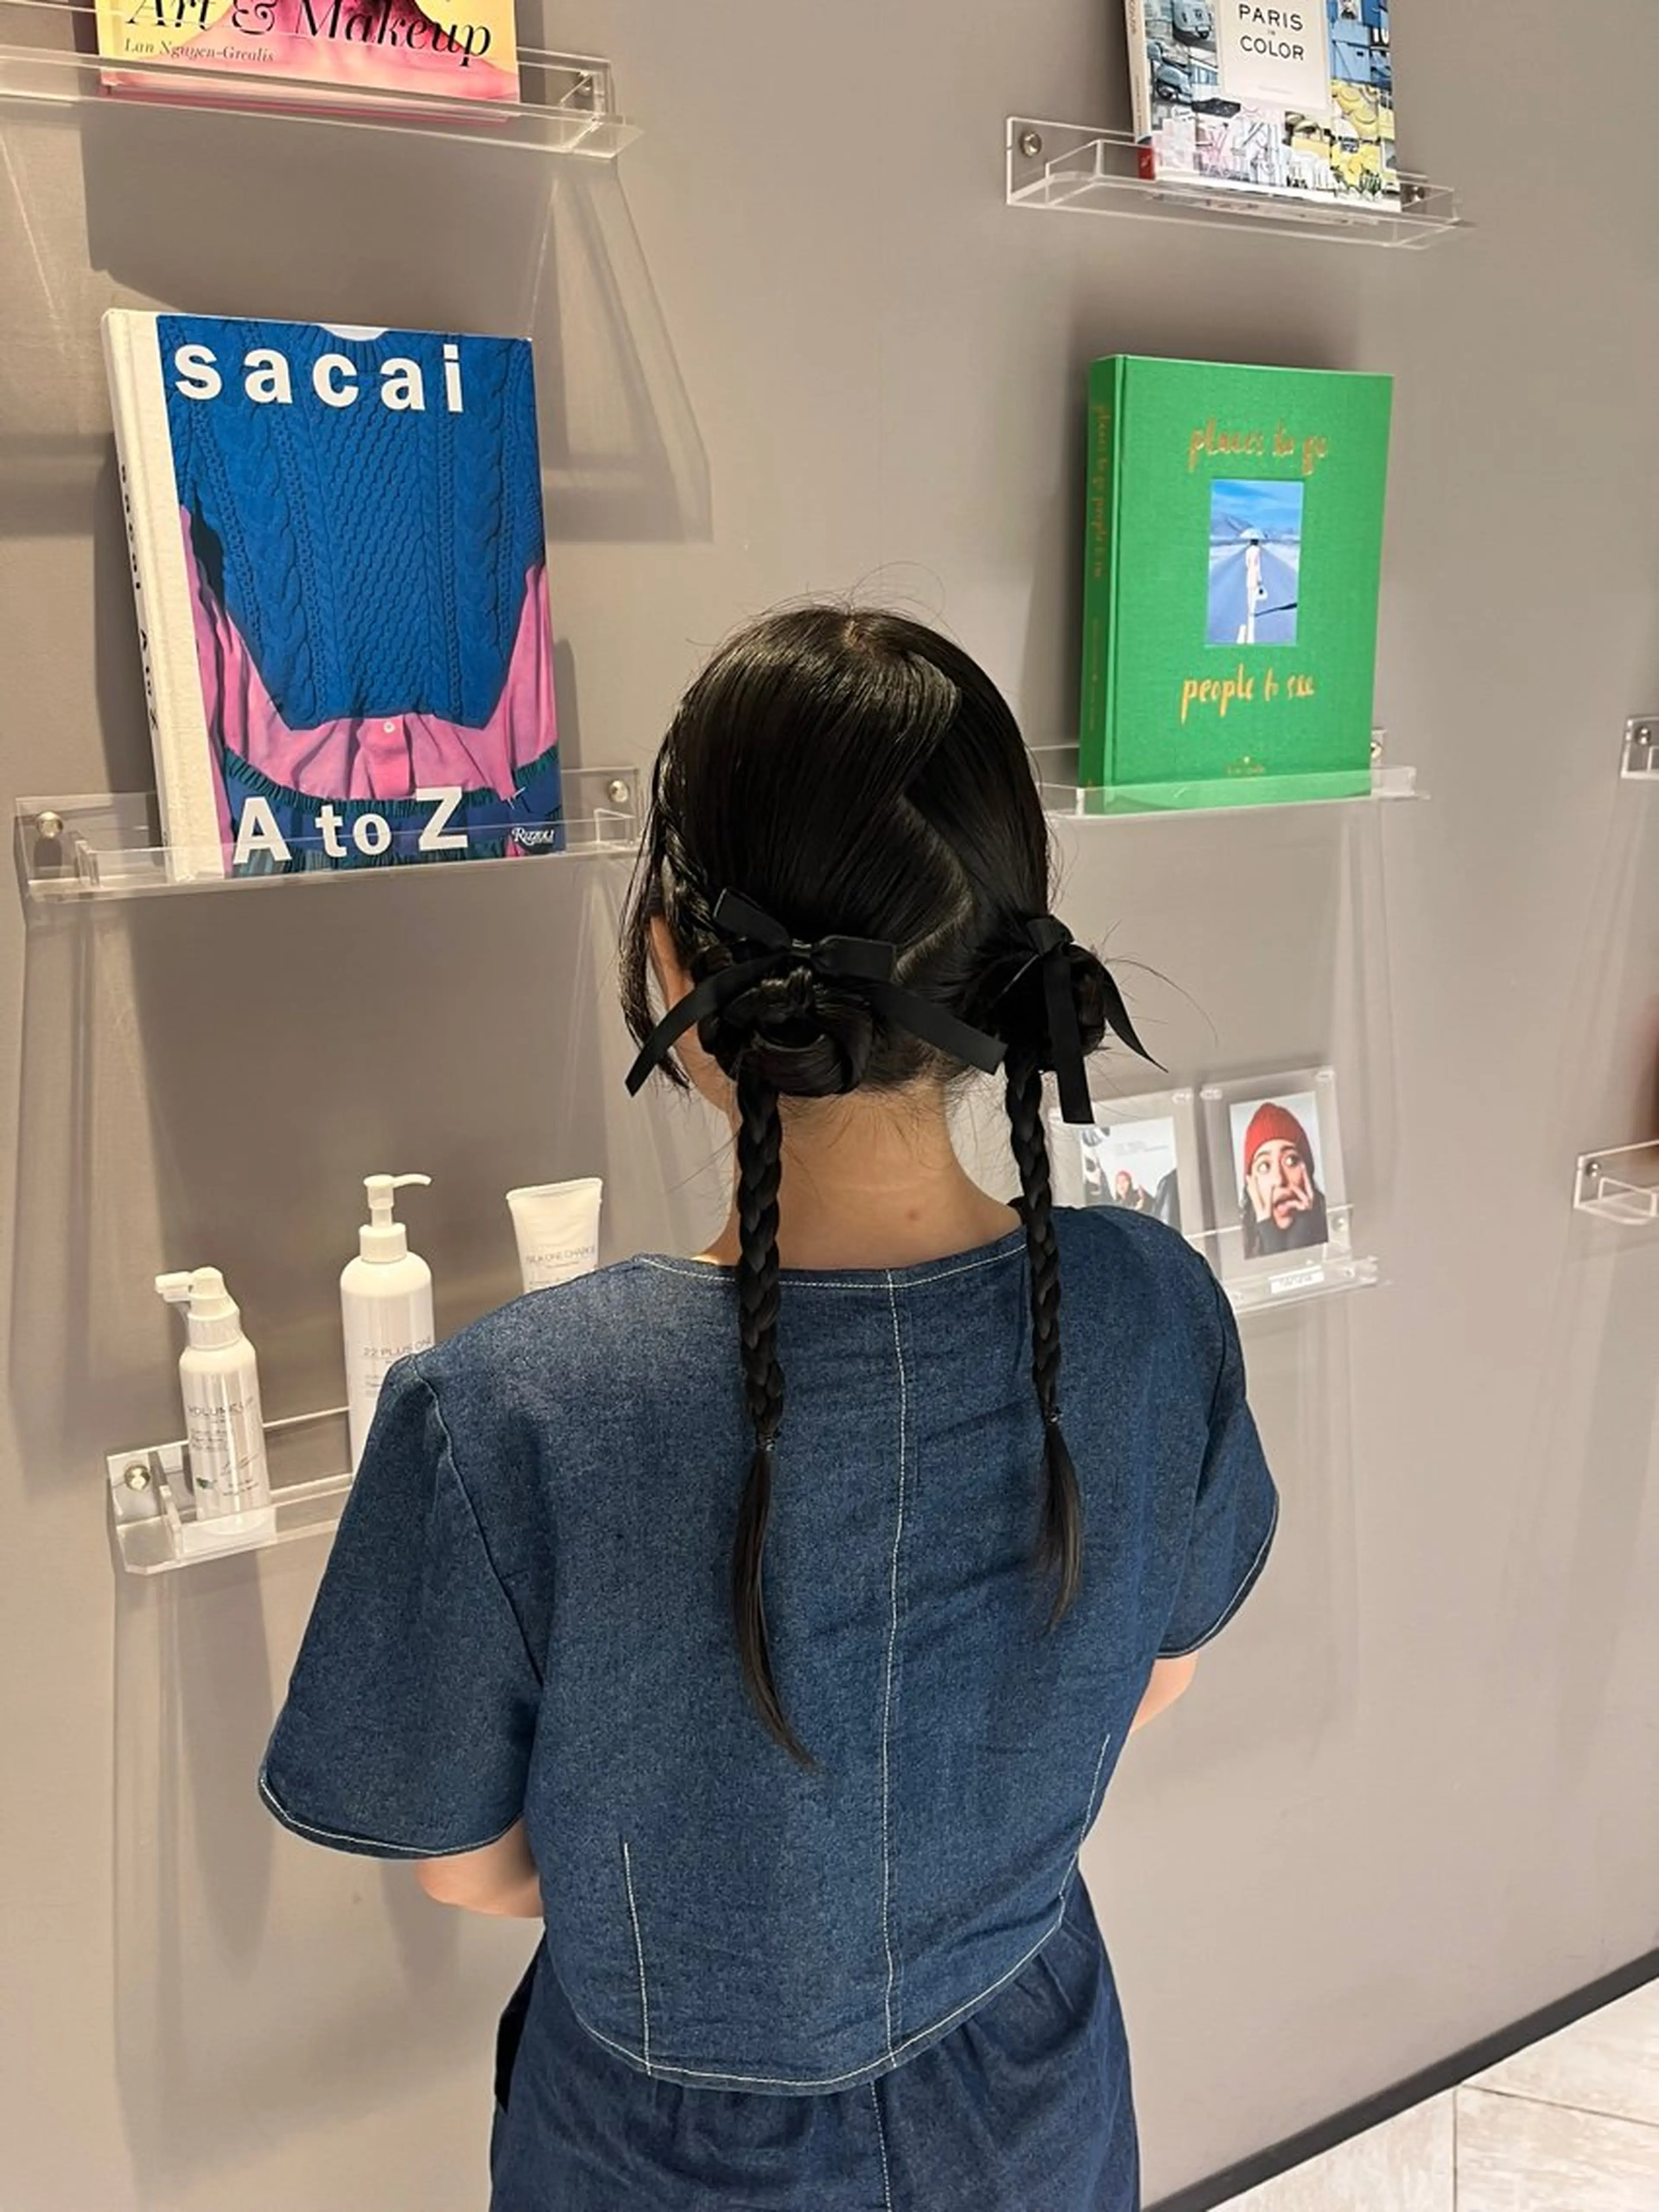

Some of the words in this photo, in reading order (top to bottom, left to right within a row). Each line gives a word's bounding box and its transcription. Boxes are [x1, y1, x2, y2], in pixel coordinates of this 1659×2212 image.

[125, 0, 216, 31] Art
[232, 0, 281, 35] &
[296, 0, 491, 67] Makeup
[125, 38, 154, 53] Lan
[1239, 3, 1303, 32] PARIS
[1239, 35, 1304, 60] COLOR
[174, 343, 463, 413] sacai
[1181, 661, 1255, 727] people
[233, 796, 292, 864] A
[315, 804, 392, 857] to
[415, 786, 468, 852] Z
